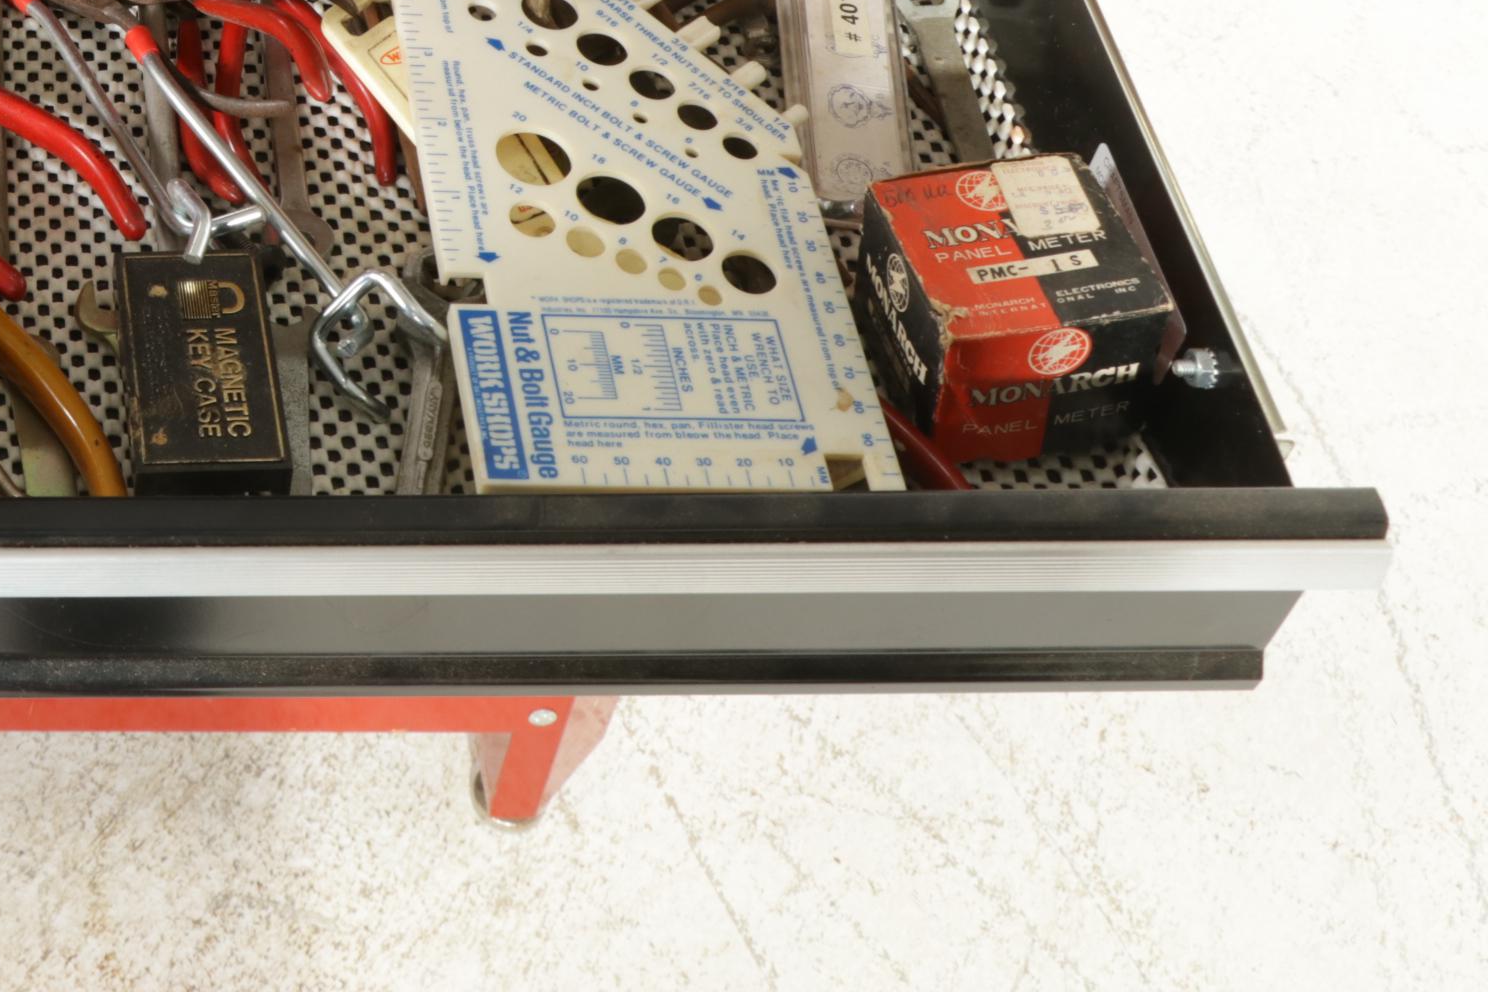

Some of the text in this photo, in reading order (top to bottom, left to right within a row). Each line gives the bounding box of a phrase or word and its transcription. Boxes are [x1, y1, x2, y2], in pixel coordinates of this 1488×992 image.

[516, 21, 535, 35] 1/4
[594, 8, 620, 28] 9/16
[670, 37, 690, 53] 3/8
[845, 31, 863, 43] #
[575, 59, 590, 73] 10
[633, 21, 672, 53] THREAD
[670, 51, 701, 76] NUTS
[699, 72, 718, 87] FIT
[717, 86, 733, 99] TO
[651, 52, 670, 67] 1/2
[687, 80, 712, 101] 7/16
[721, 77, 747, 97] 5/16
[508, 50, 735, 199] STANDARD INCH BOLT & SCREW GAUGE
[512, 111, 528, 123] 20
[734, 116, 755, 133] 3/8
[773, 116, 792, 132] 1/4
[522, 80, 703, 198] METRIC BOLT & SCREW GAUGE
[591, 152, 607, 166] 18
[756, 168, 776, 177] MM
[509, 183, 525, 195] 12
[665, 192, 681, 205] 16
[564, 209, 580, 222] 10
[618, 236, 629, 246] 8
[730, 228, 747, 241] 14
[934, 229, 1108, 264] PANEL METER
[659, 256, 668, 264] 7
[976, 264, 1031, 283] PMC-
[1069, 254, 1082, 267] S
[693, 273, 703, 282] 6
[207, 279, 222, 319] Master
[972, 277, 1141, 312] MONARCH ELECTRONICS
[1114, 285, 1137, 295] INC
[787, 181, 874, 448] 10 20 30 40 50 60 70 80 90
[697, 321, 710, 345] with
[467, 315, 505, 389] WORK
[619, 321, 644, 376] 0 1/2
[549, 328, 579, 405] 0 10 20
[611, 354, 625, 375] MM
[671, 346, 694, 393] INCHES
[703, 349, 717, 374] zero
[709, 323, 741, 415] Place head even
[723, 324, 739, 352] INCH
[735, 367, 756, 412] METRIC
[751, 332, 781, 406] WRENCH TO
[765, 335, 793, 402] WHAT SIZE
[186, 327, 223, 439] KEY CASE
[213, 327, 253, 438] MAGNETIC
[970, 361, 1142, 407] MONARCH
[506, 311, 559, 480] Nut & Bolt Gauge
[713, 388, 729, 415] read
[562, 419, 601, 429] Metric
[747, 421, 774, 430] head
[777, 423, 815, 431] screws
[961, 399, 1131, 438] PANEL METER
[480, 391, 521, 471] SHOPS
[566, 430, 584, 438] are
[586, 430, 641, 438] measured
[644, 430, 672, 439] from
[713, 431, 732, 440] the
[767, 431, 800, 440] Place
[567, 439, 623, 448] head here
[571, 454, 794, 467] 60 50 40 30 20 10
[817, 465, 830, 485] MM
